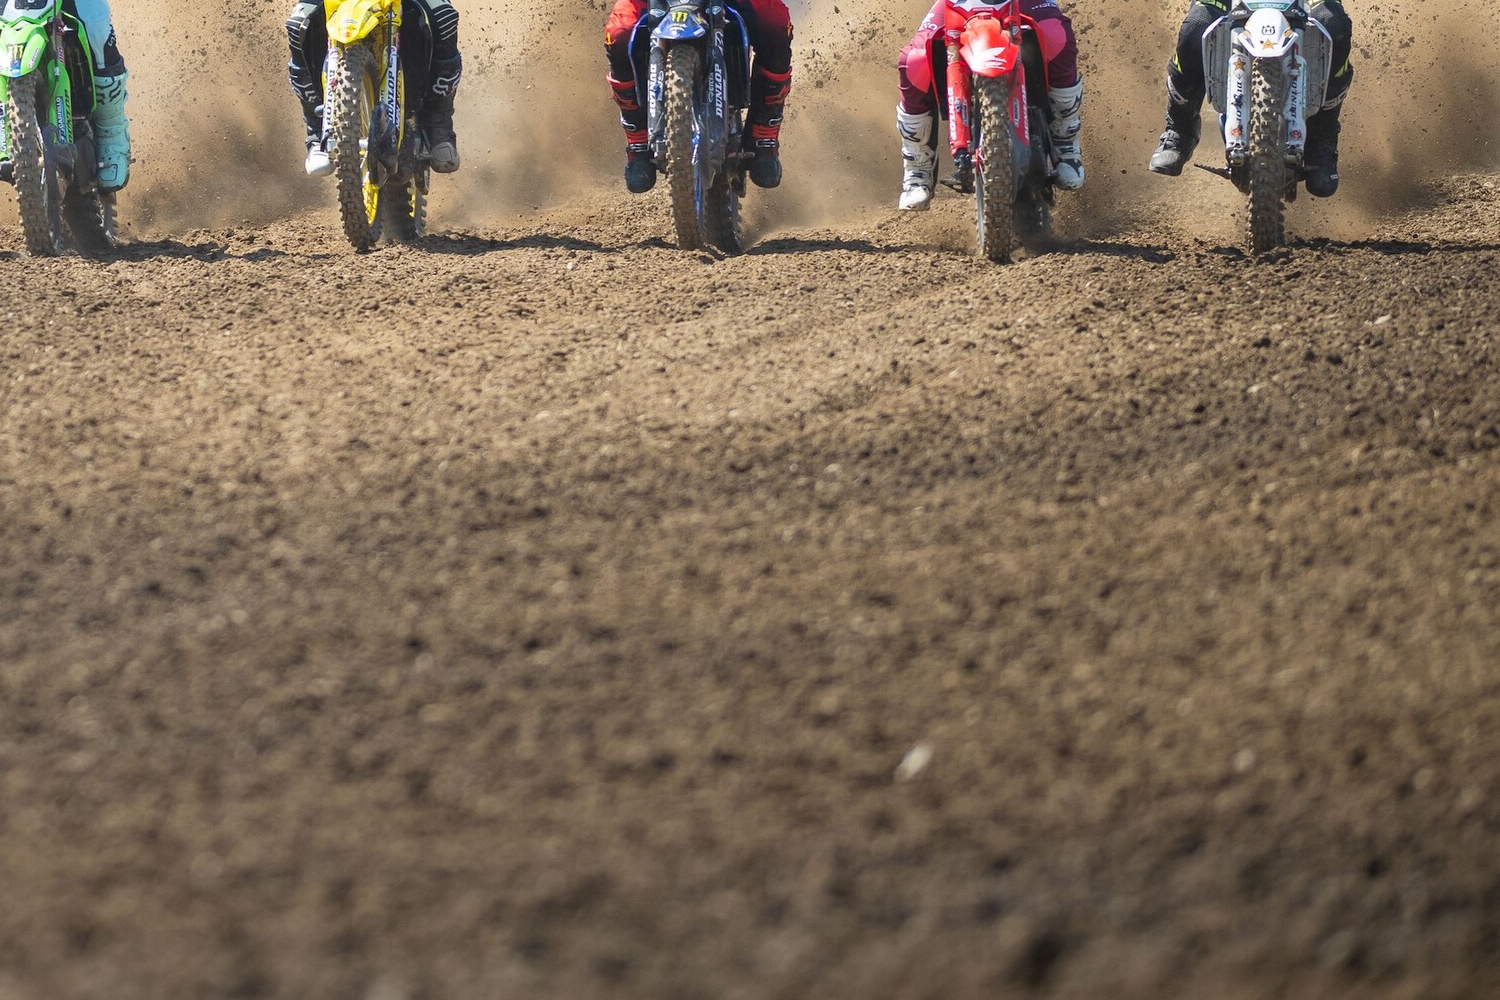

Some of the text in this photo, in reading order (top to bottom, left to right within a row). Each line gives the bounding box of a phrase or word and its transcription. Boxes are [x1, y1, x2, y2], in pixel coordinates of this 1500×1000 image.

[649, 63, 657, 118] DUNLOP
[715, 63, 723, 118] DUNLOP
[948, 86, 957, 141] DUNLOP
